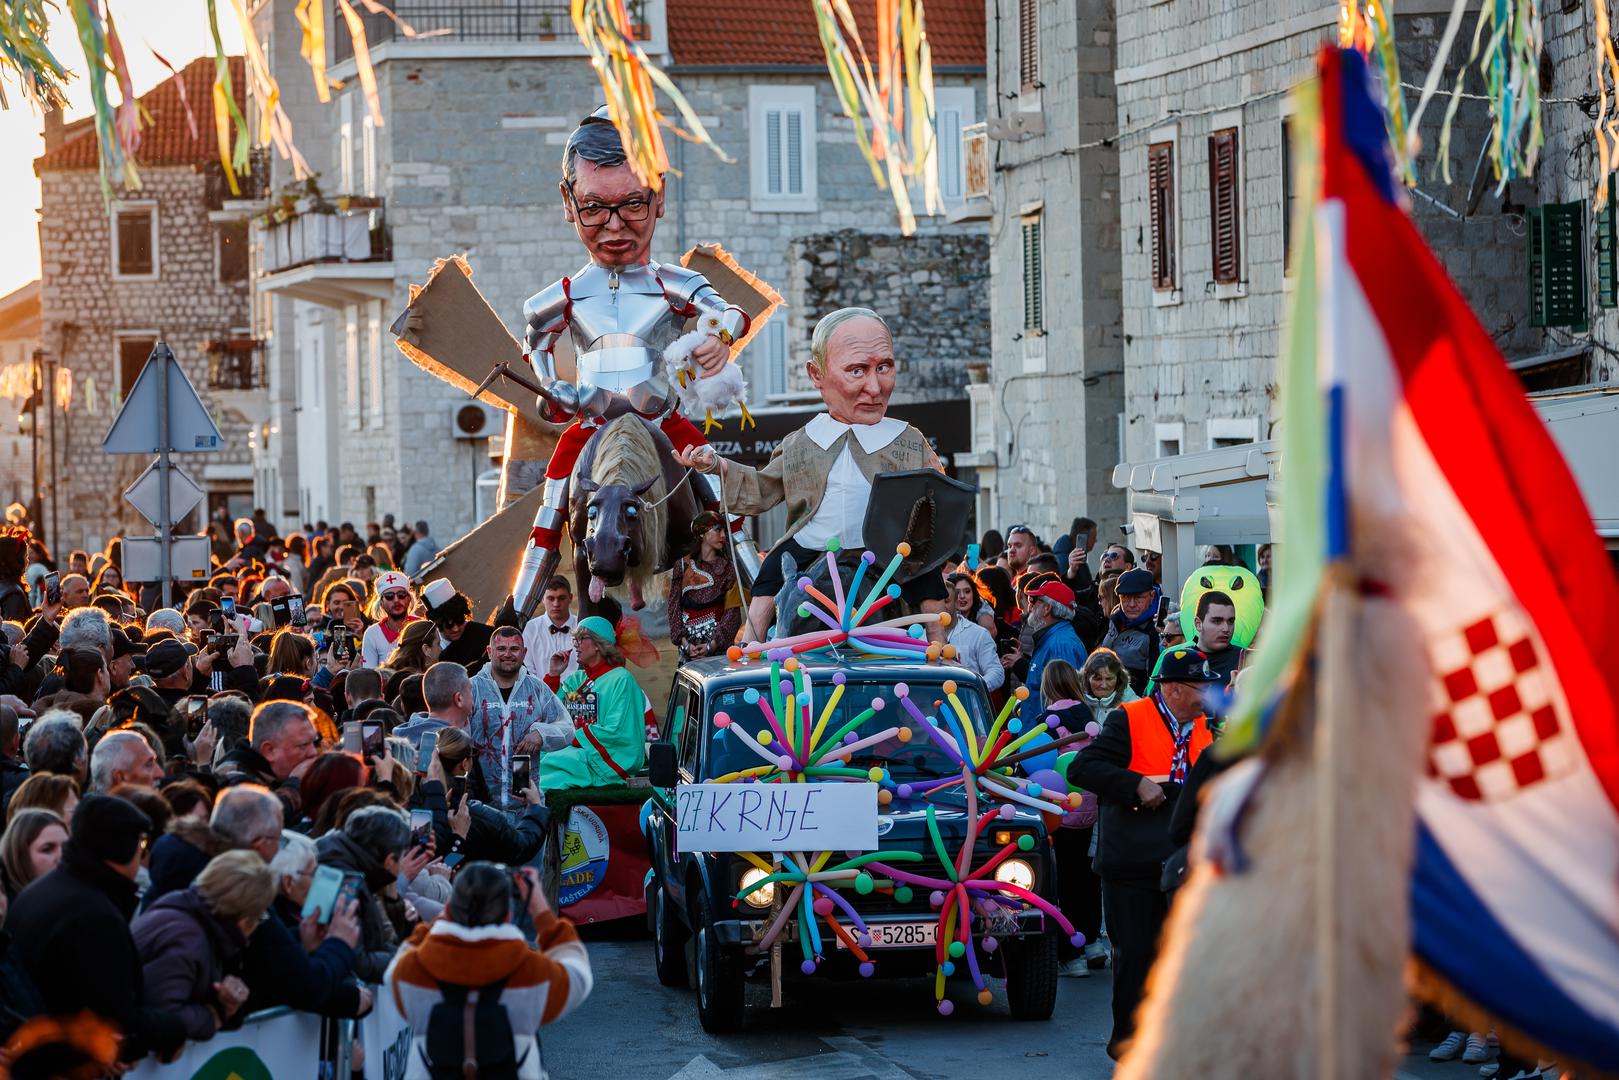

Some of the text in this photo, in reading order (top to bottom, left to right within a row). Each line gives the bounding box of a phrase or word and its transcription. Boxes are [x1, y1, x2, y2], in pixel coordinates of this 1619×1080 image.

[711, 440, 743, 455] IZZA
[754, 440, 783, 454] PAS
[559, 871, 594, 886] LADE
[850, 927, 870, 945] S
